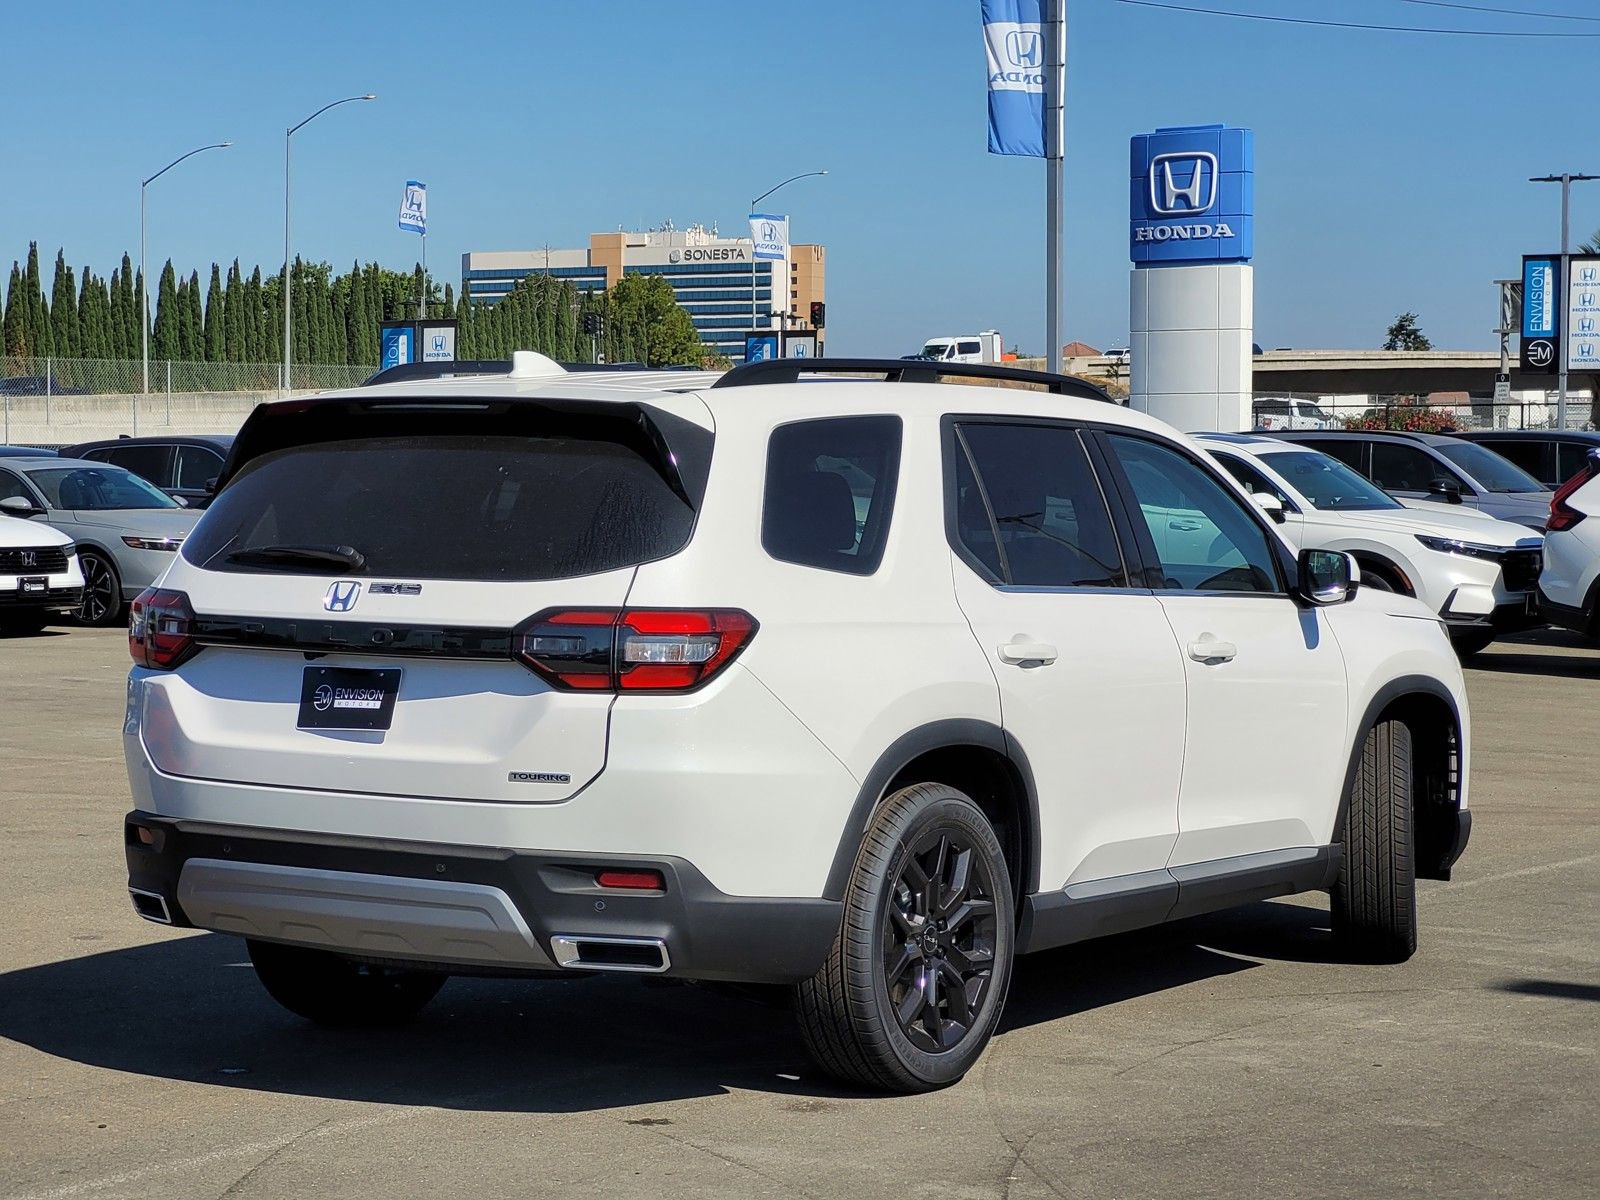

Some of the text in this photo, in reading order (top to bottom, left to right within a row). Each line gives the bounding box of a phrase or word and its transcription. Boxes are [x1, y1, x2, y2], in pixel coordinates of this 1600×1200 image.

[1135, 223, 1235, 241] HONDA
[684, 248, 745, 261] SONESTA
[1530, 266, 1544, 332] ENVISION
[335, 688, 385, 701] ENVISION
[511, 772, 569, 782] TOURING
